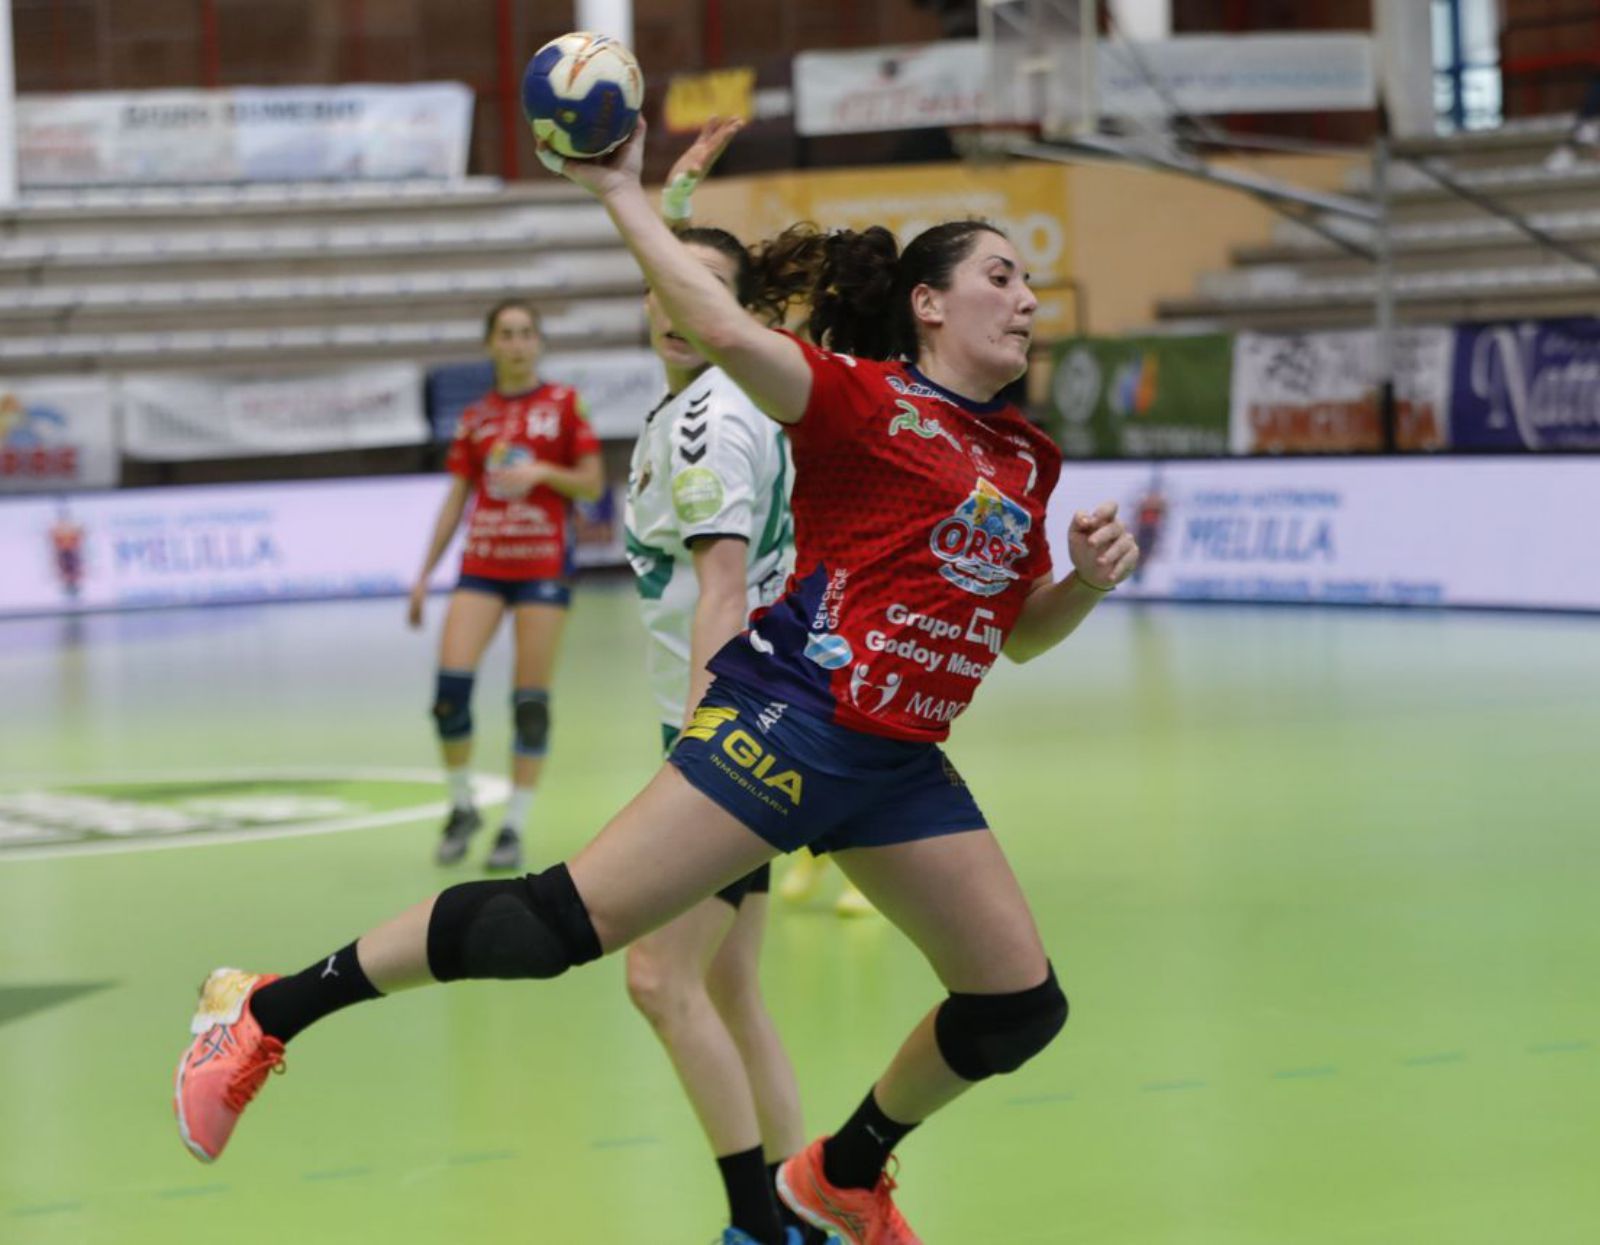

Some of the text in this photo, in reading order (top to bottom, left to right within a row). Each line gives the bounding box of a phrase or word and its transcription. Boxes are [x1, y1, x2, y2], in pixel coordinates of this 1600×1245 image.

[886, 603, 962, 639] Grupo
[865, 629, 944, 672] Godoy
[709, 753, 789, 816] INMOBILIARIA
[722, 729, 802, 807] GIA
